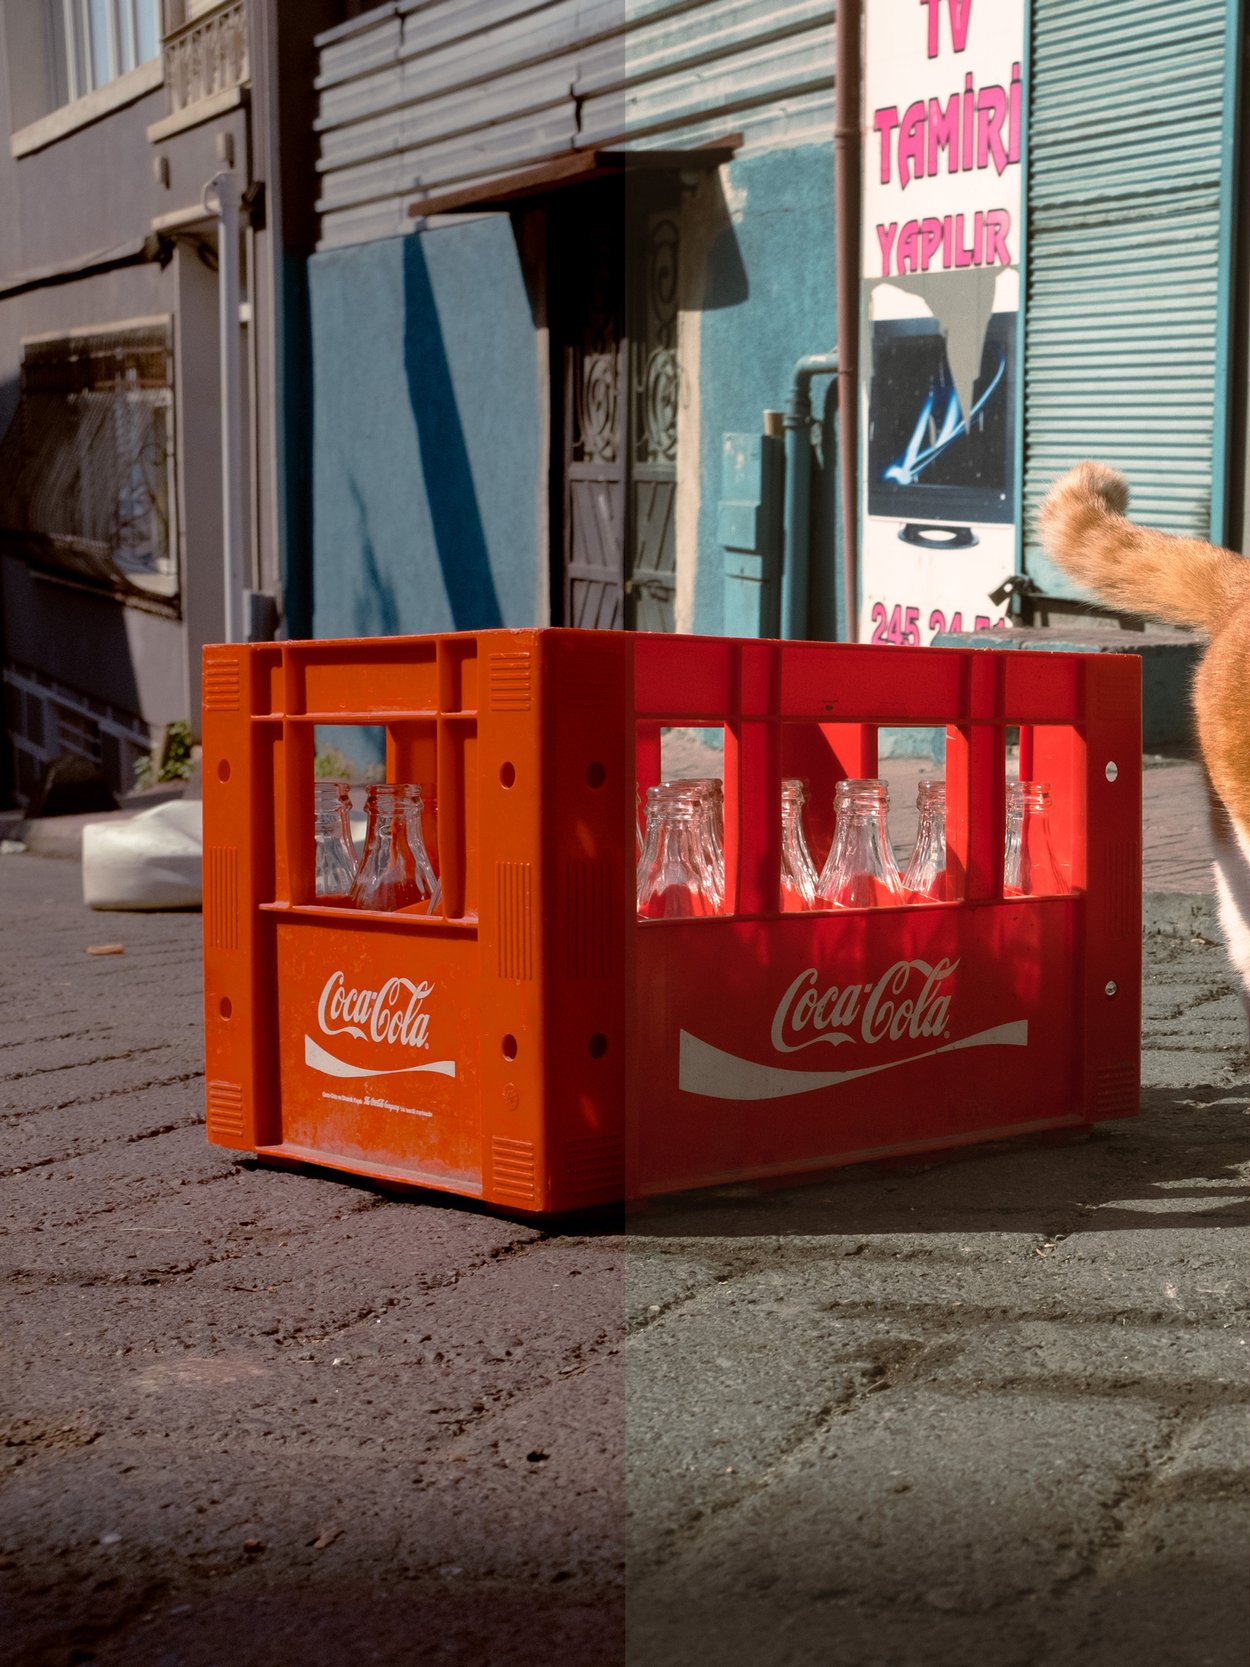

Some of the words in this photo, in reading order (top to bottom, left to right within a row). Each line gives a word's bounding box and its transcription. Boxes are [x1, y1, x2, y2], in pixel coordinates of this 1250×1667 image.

[920, 0, 972, 59] TV
[873, 61, 1022, 191] TAMİRİ
[876, 208, 1012, 277] YAPILIR
[871, 601, 921, 647] 245
[318, 970, 435, 1050] Coca-Cola
[771, 957, 961, 1053] Coca-Cola
